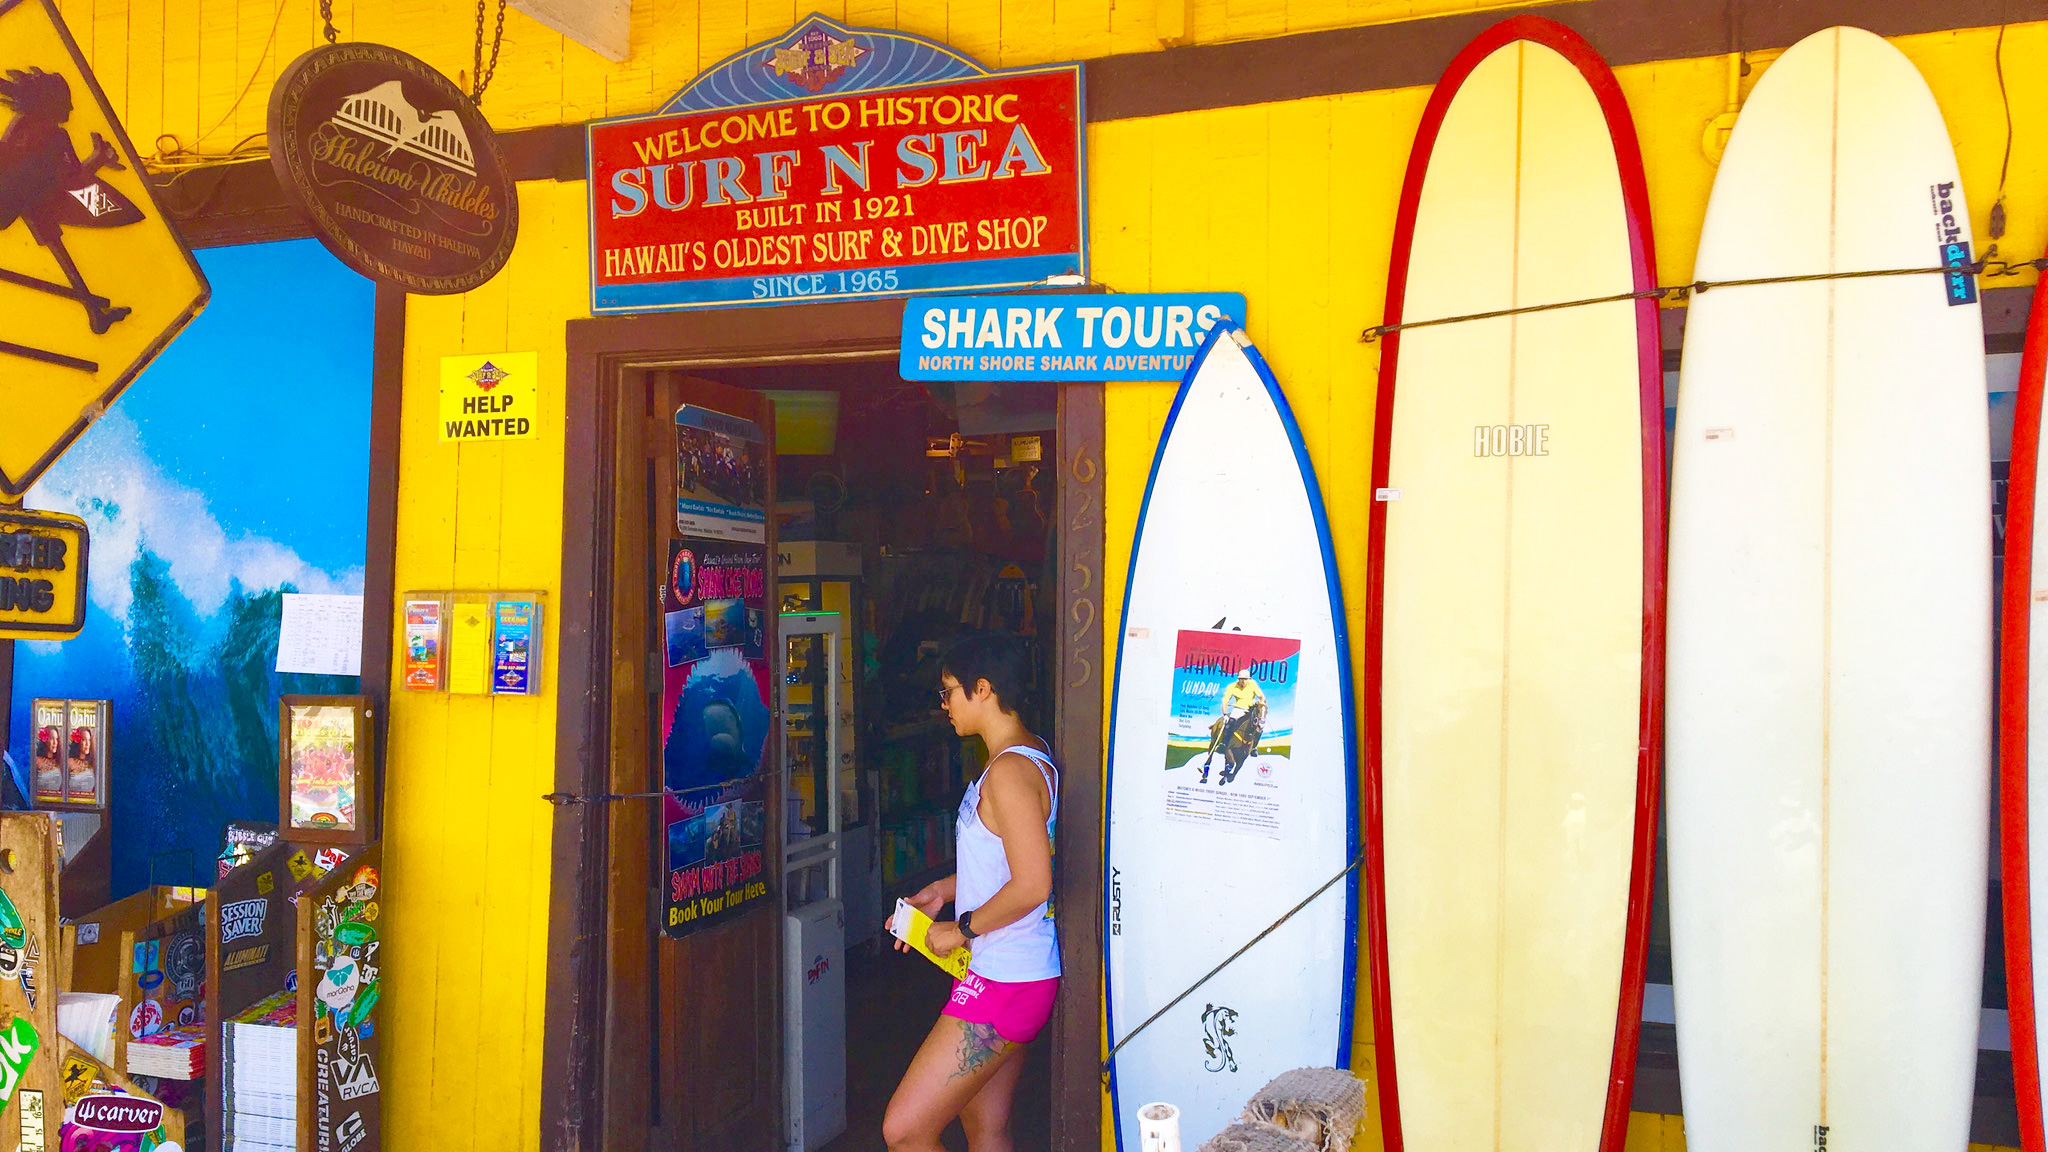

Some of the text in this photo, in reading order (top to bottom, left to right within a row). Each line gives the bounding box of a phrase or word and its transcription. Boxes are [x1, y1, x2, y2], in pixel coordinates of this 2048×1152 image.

[633, 94, 1020, 165] WELCOME TO HISTORIC
[611, 123, 1053, 220] SURF N SEA
[409, 161, 500, 221] Ukuleles
[736, 193, 915, 231] BUILT IN 1921
[336, 202, 481, 261] HANDCRAFTED IN HALEIWA
[392, 236, 431, 261] HAWAII
[605, 215, 1048, 278] HAWAII'S OLDEST SURF & DIVE SHOP
[752, 268, 899, 299] SINCE 1965
[921, 304, 1222, 349] SHARK TOURS
[918, 355, 975, 372] NORTH
[979, 355, 1035, 372] SHORE
[1040, 354, 1098, 372] SHARK
[463, 394, 514, 415] HELP
[445, 417, 530, 439] WANTED
[1474, 424, 1550, 458] HOBIE
[1250, 657, 1289, 684] POLO
[1180, 680, 1221, 697] SUNDAY
[37, 706, 63, 728] Oahu
[69, 706, 96, 729] Oahu
[669, 881, 766, 927] Book Your Tour Here
[1112, 866, 1122, 922] RUSTY
[221, 901, 266, 926] SESSION
[224, 917, 261, 941] SAVER
[342, 1080, 379, 1100] RVCA
[97, 1104, 160, 1125] carver
